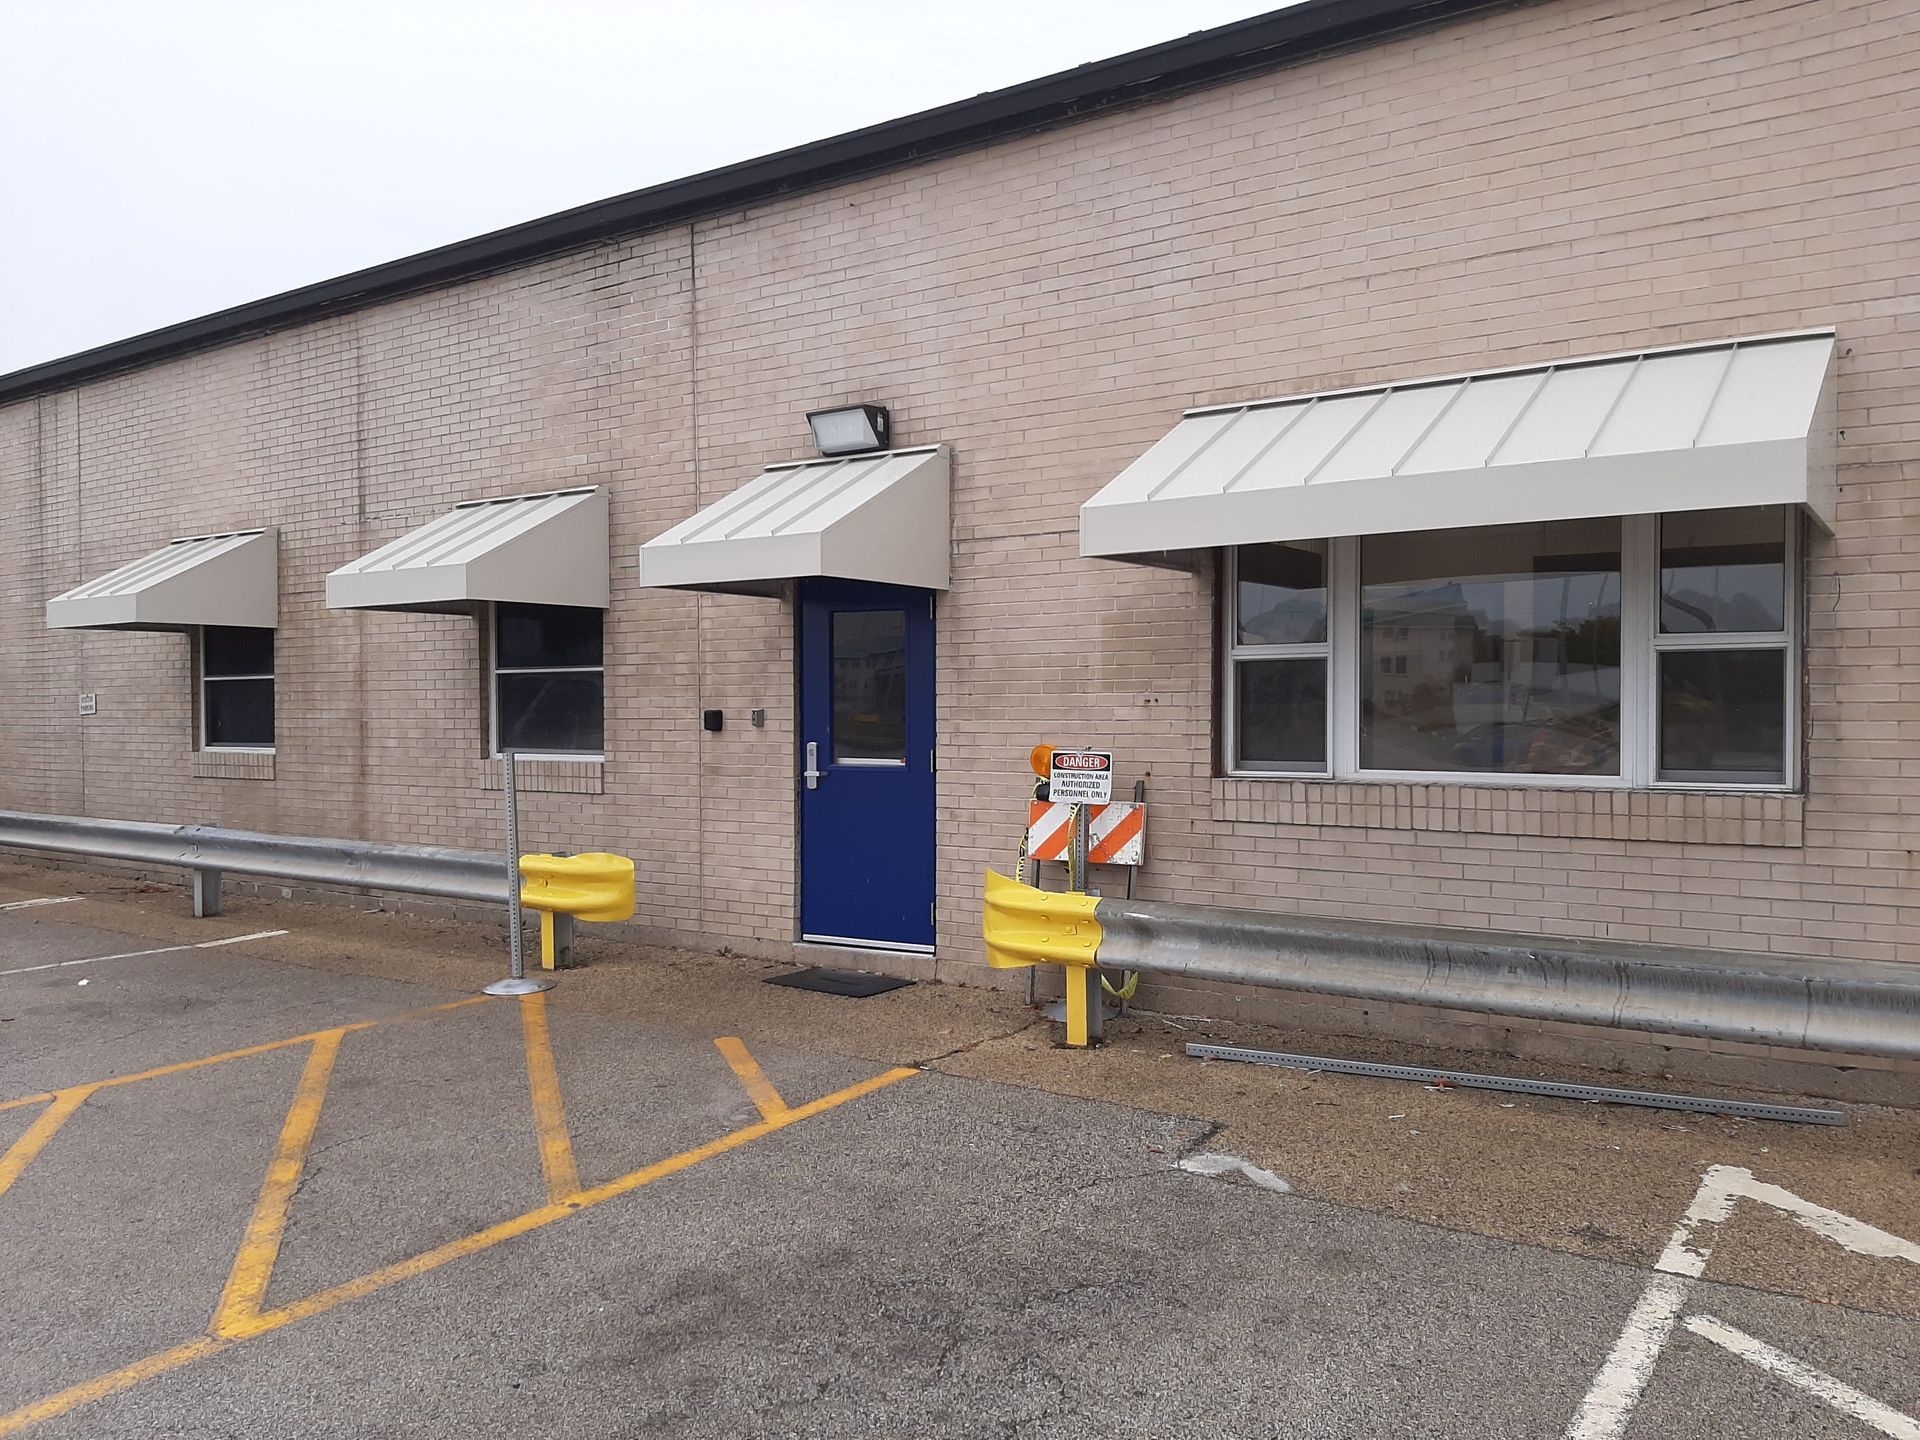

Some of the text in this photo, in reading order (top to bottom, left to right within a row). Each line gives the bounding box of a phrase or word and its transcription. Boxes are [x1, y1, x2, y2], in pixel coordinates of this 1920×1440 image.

[1063, 757, 1100, 767] DANGER
[1061, 780, 1101, 789] AUTHORIZED
[1053, 789, 1108, 798] PERSONNEL ONLY
